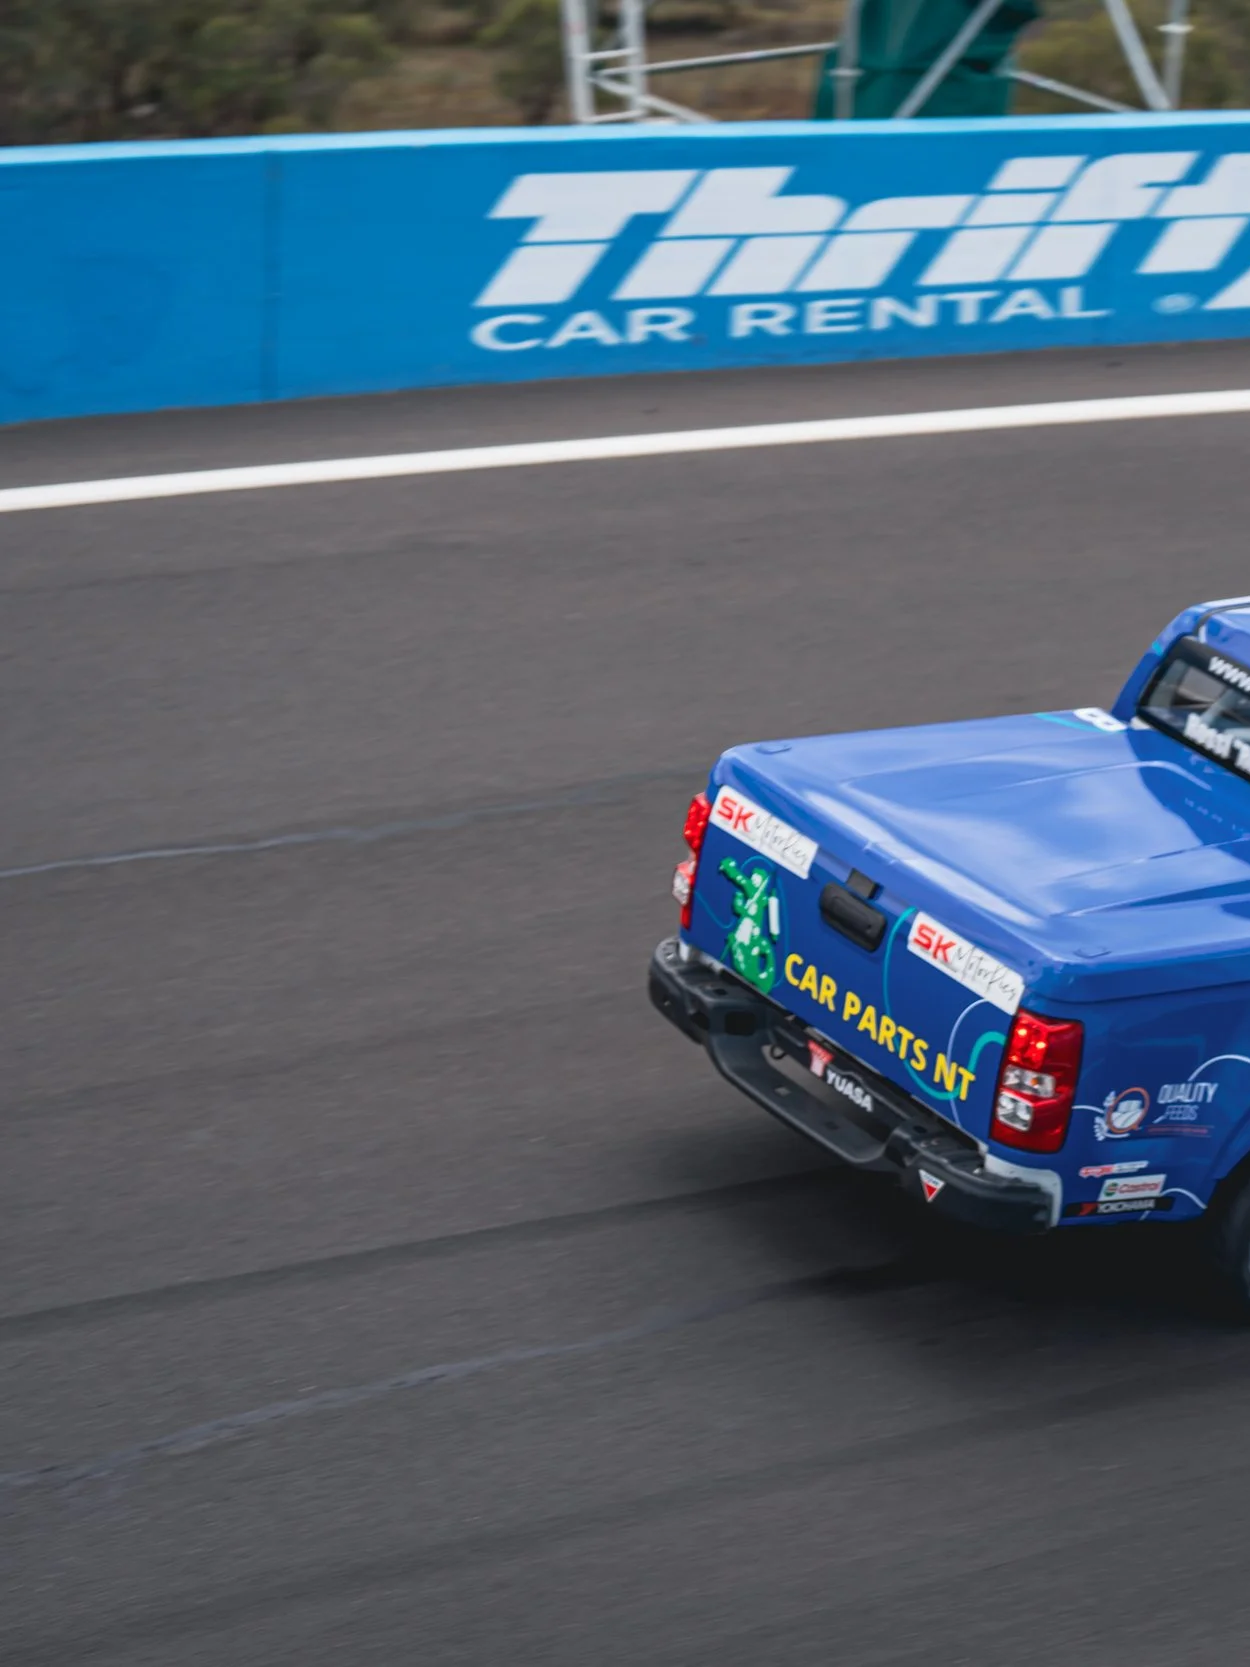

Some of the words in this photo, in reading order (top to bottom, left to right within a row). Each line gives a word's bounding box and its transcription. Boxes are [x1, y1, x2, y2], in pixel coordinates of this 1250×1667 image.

[471, 306, 694, 351] CAR
[730, 287, 1114, 340] RENTAL
[717, 796, 755, 833] SK
[912, 924, 957, 963] SK
[784, 953, 837, 1012] CAR
[842, 996, 928, 1071] PARTS
[934, 1052, 976, 1100] NT
[826, 1069, 874, 1112] YUASA
[1158, 1082, 1219, 1105] QUALITY
